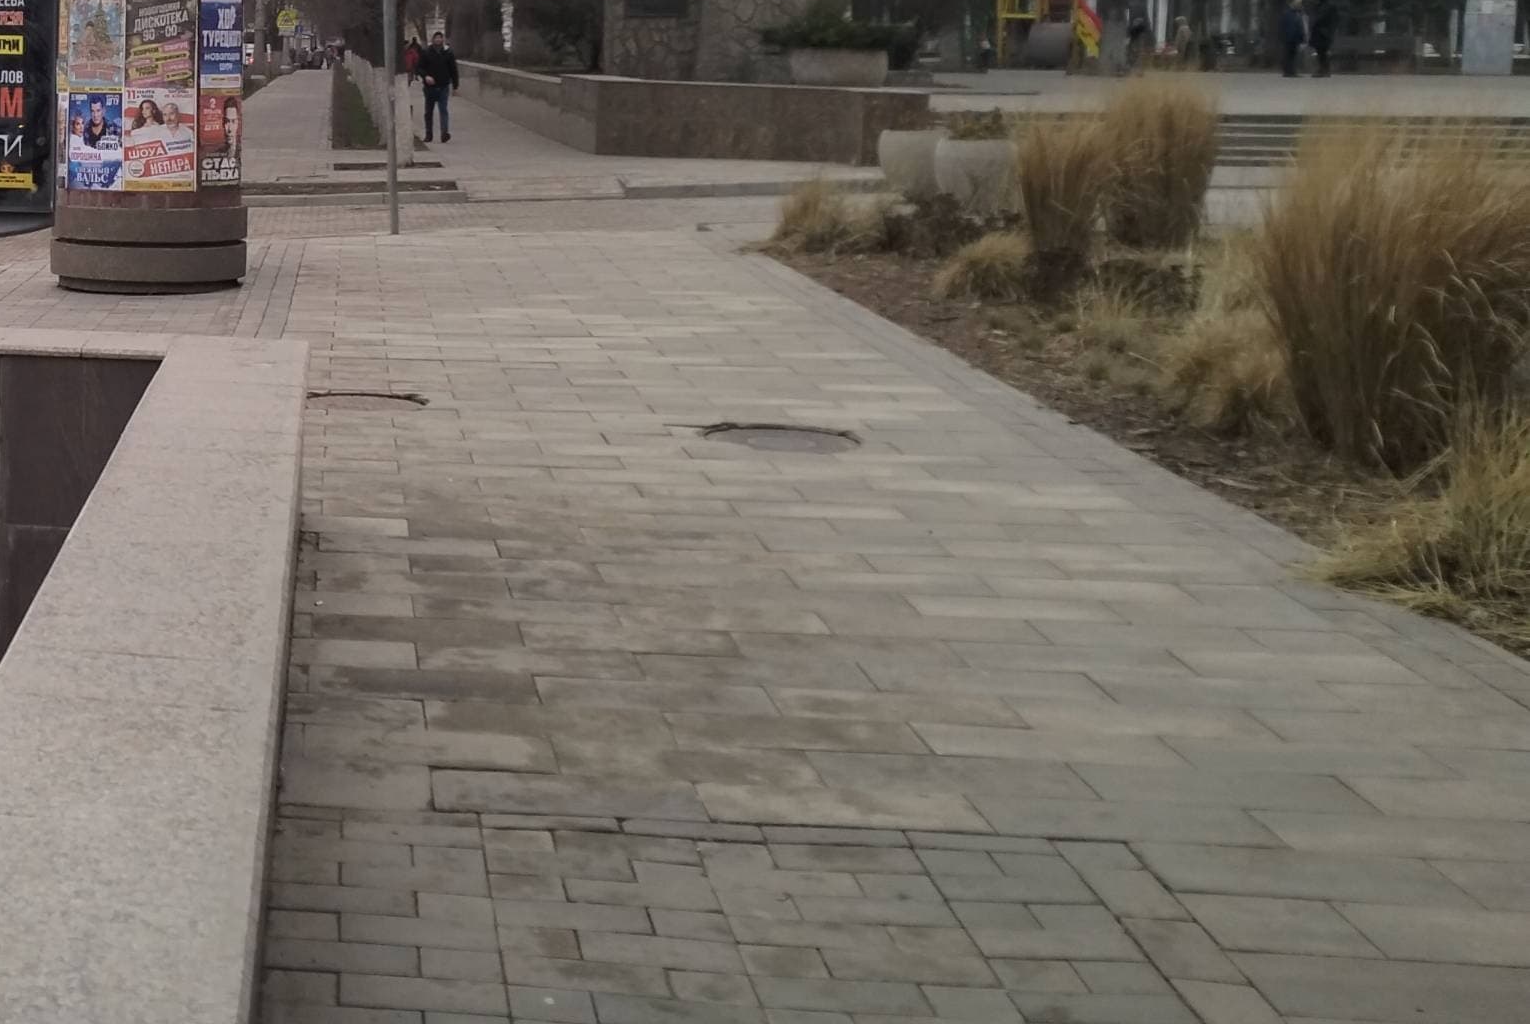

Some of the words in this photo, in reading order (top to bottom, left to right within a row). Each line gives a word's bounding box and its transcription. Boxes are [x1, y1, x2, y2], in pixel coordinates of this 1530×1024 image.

[134, 10, 189, 33] ДИСКОТЕКА
[128, 147, 165, 159] ШОУА
[150, 158, 191, 176] НЕПАРА
[202, 157, 237, 169] СТАС
[77, 173, 109, 185] ВАЛЬС
